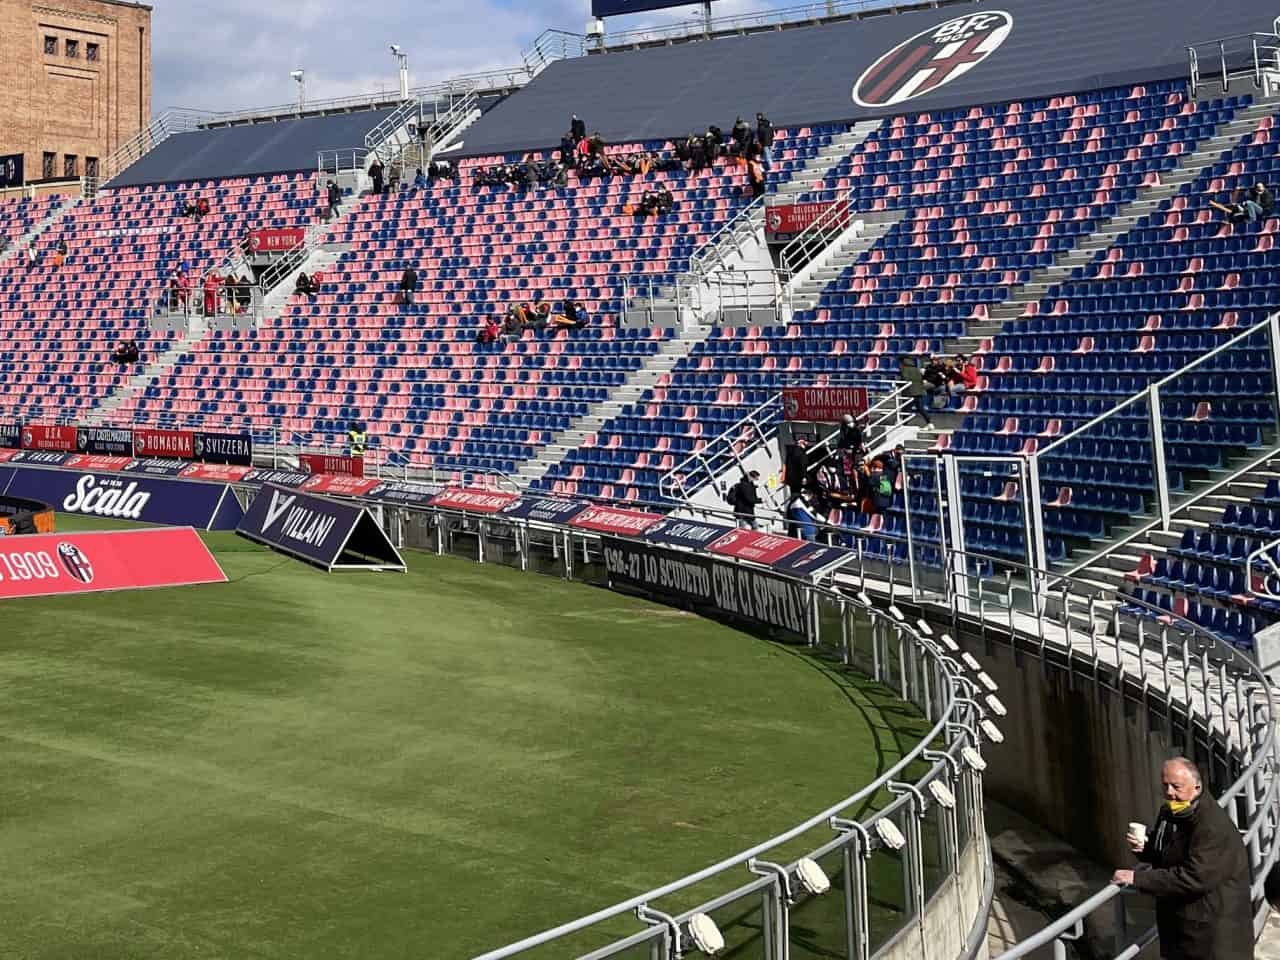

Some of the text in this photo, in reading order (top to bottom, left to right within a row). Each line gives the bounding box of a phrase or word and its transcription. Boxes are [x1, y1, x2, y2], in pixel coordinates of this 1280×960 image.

[805, 390, 859, 407] COMACCHIO
[147, 434, 191, 452] ROMAGNA
[206, 438, 249, 456] SVIZZERA
[63, 474, 151, 519] Scala
[281, 505, 337, 547] VILLANI
[642, 553, 658, 584] LO
[660, 556, 710, 598] SCUDETTO
[712, 562, 738, 613] CHE
[737, 568, 754, 617] CI
